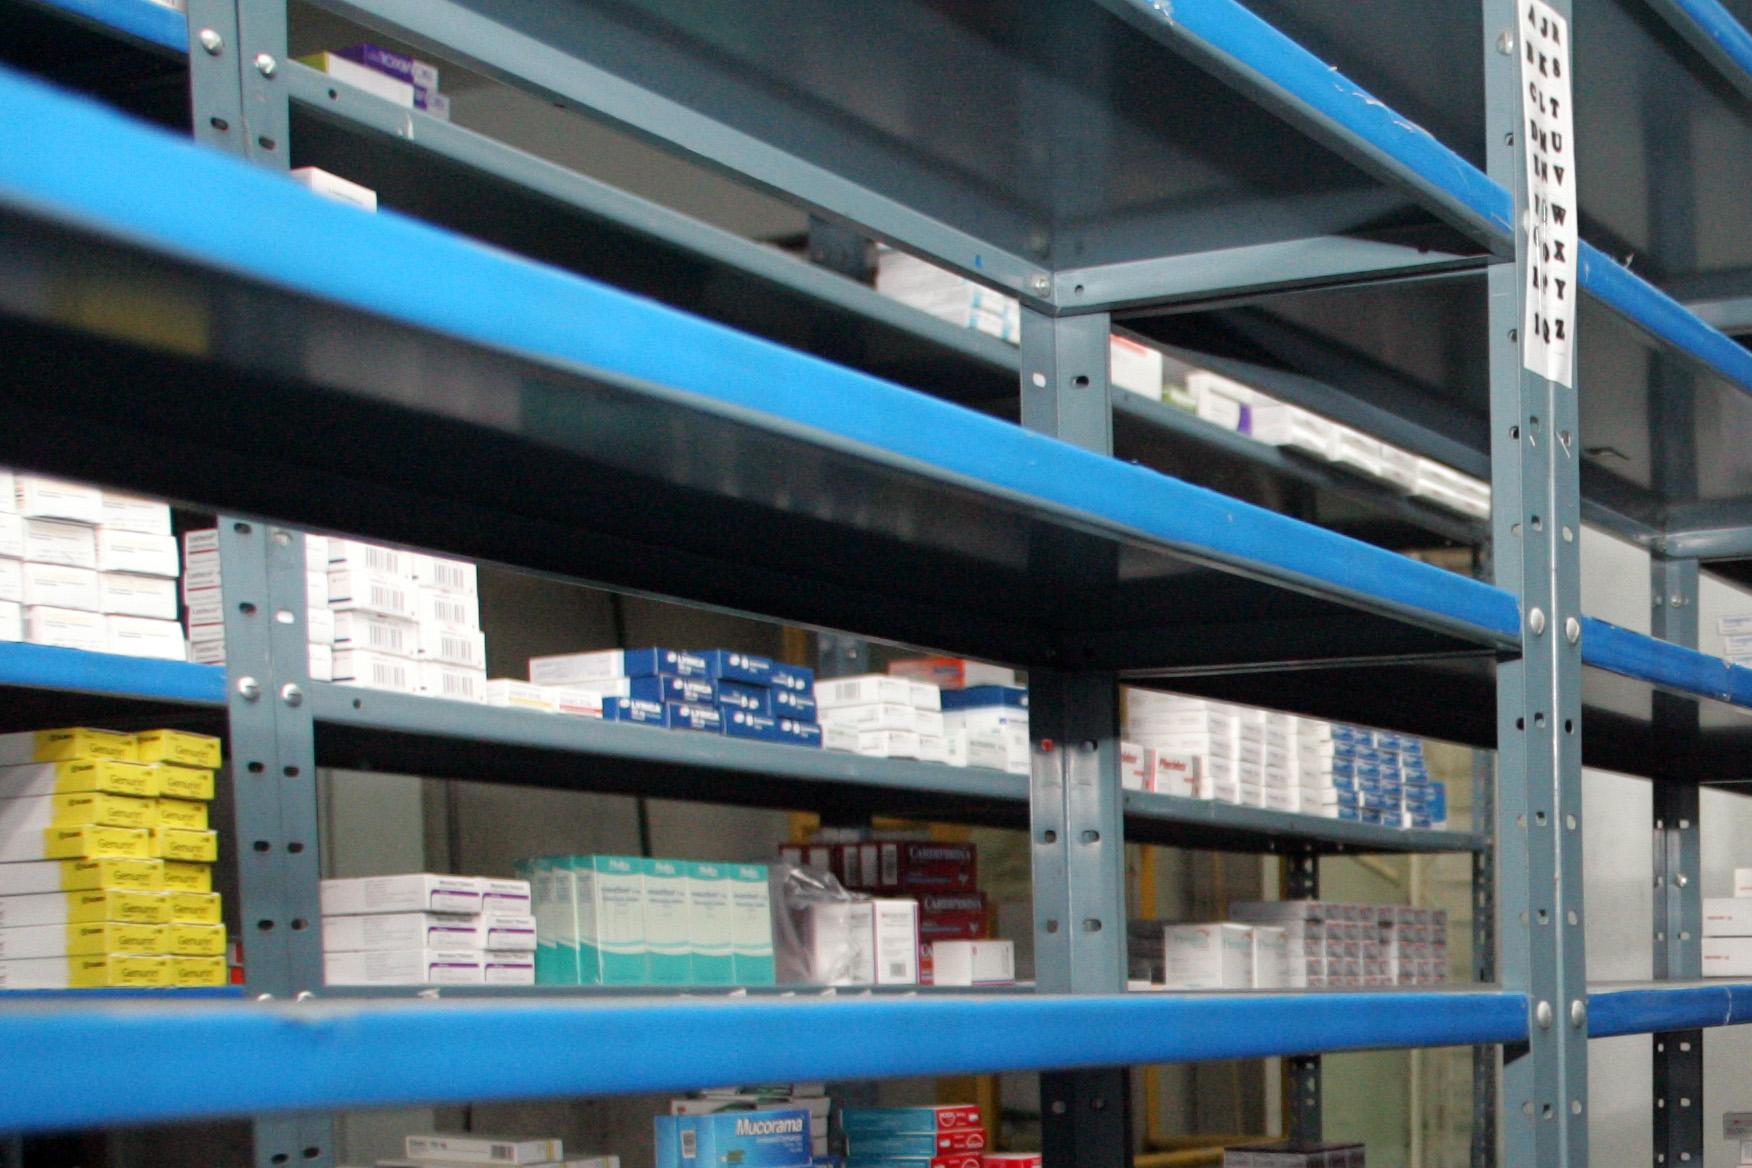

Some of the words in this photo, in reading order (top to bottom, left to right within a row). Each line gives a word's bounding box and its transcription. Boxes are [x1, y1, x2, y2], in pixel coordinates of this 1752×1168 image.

[1528, 3, 1536, 29] A
[1541, 17, 1548, 39] J
[1552, 21, 1561, 45] R
[1539, 52, 1548, 78] K
[1529, 81, 1537, 103] C
[1539, 91, 1546, 114] L
[1550, 97, 1560, 119] T
[1530, 118, 1539, 142] D
[1551, 130, 1562, 153] U
[1553, 165, 1565, 187] V
[1551, 202, 1567, 227] W
[1554, 240, 1566, 264] X
[1554, 278, 1567, 301] Y
[1555, 319, 1566, 341] Z
[736, 1118, 803, 1136] Mucorama
